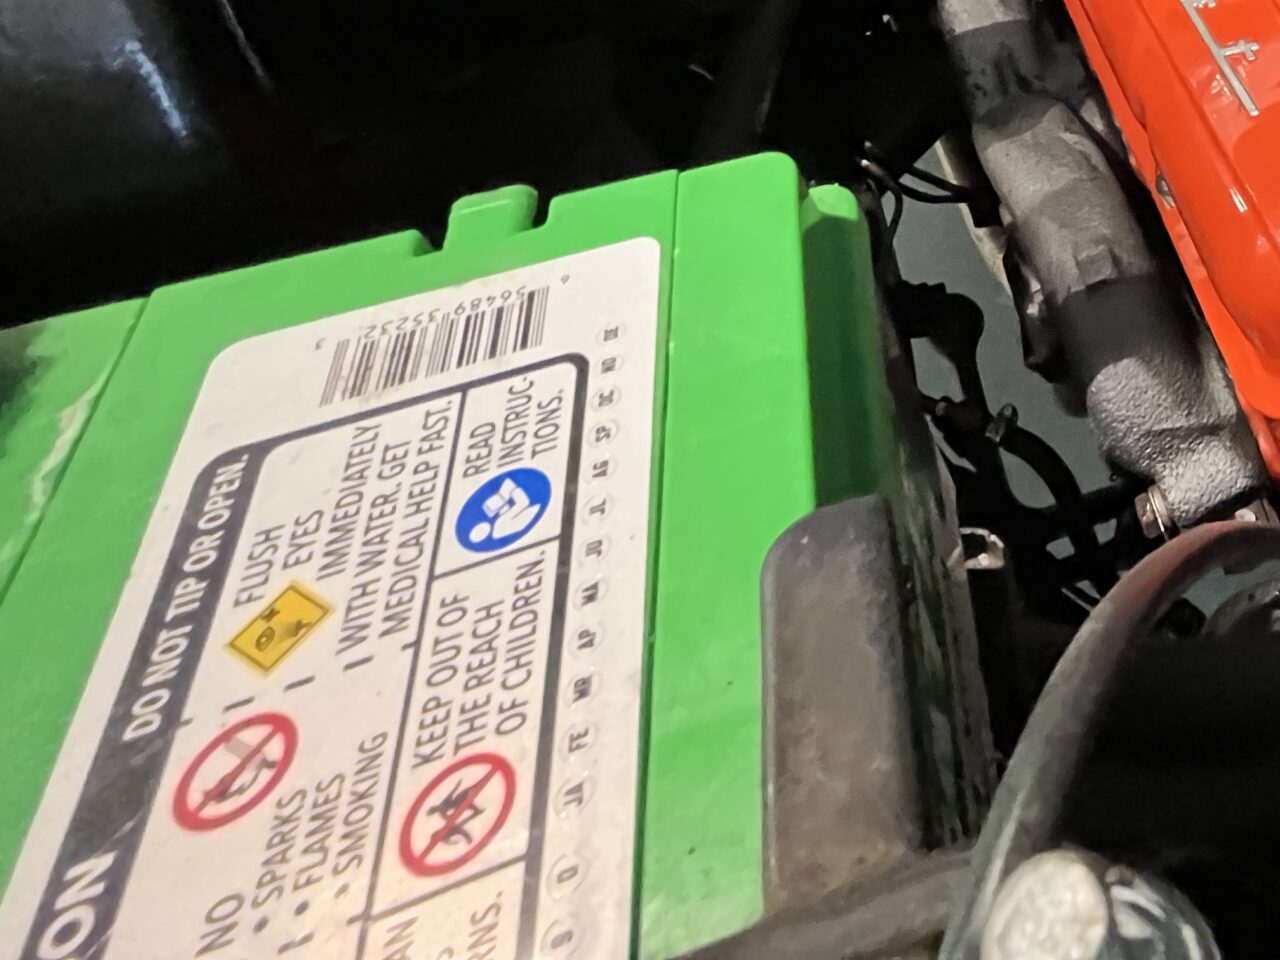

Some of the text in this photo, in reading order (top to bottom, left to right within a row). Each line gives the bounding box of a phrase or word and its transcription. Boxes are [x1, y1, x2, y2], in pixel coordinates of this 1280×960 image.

[364, 307, 441, 339] 35232
[454, 284, 527, 316] 56489
[462, 421, 496, 479] READ
[496, 376, 534, 468] INSTRUC-
[530, 388, 564, 461] TIONS.
[281, 509, 325, 571] EYES
[315, 423, 382, 582] IMMEDIATELY
[335, 440, 412, 656] WITH WATER. GET
[377, 400, 453, 639] MEDICAL HELP FAST.
[122, 452, 250, 741] DO NOT TIP OR OPEN.
[233, 523, 287, 608] FLUSH
[411, 592, 470, 770] KEEP OUT OF
[453, 599, 505, 757] THE REACH
[494, 549, 546, 737] OF CHILDREN.
[576, 628, 597, 651] AP
[567, 726, 590, 753] FE
[292, 772, 346, 892] FLAMES
[331, 731, 389, 877] SMOKING
[562, 781, 585, 807] JA
[250, 788, 308, 909] SPARKS
[36, 850, 118, 960] ON
[195, 893, 246, 958] NO
